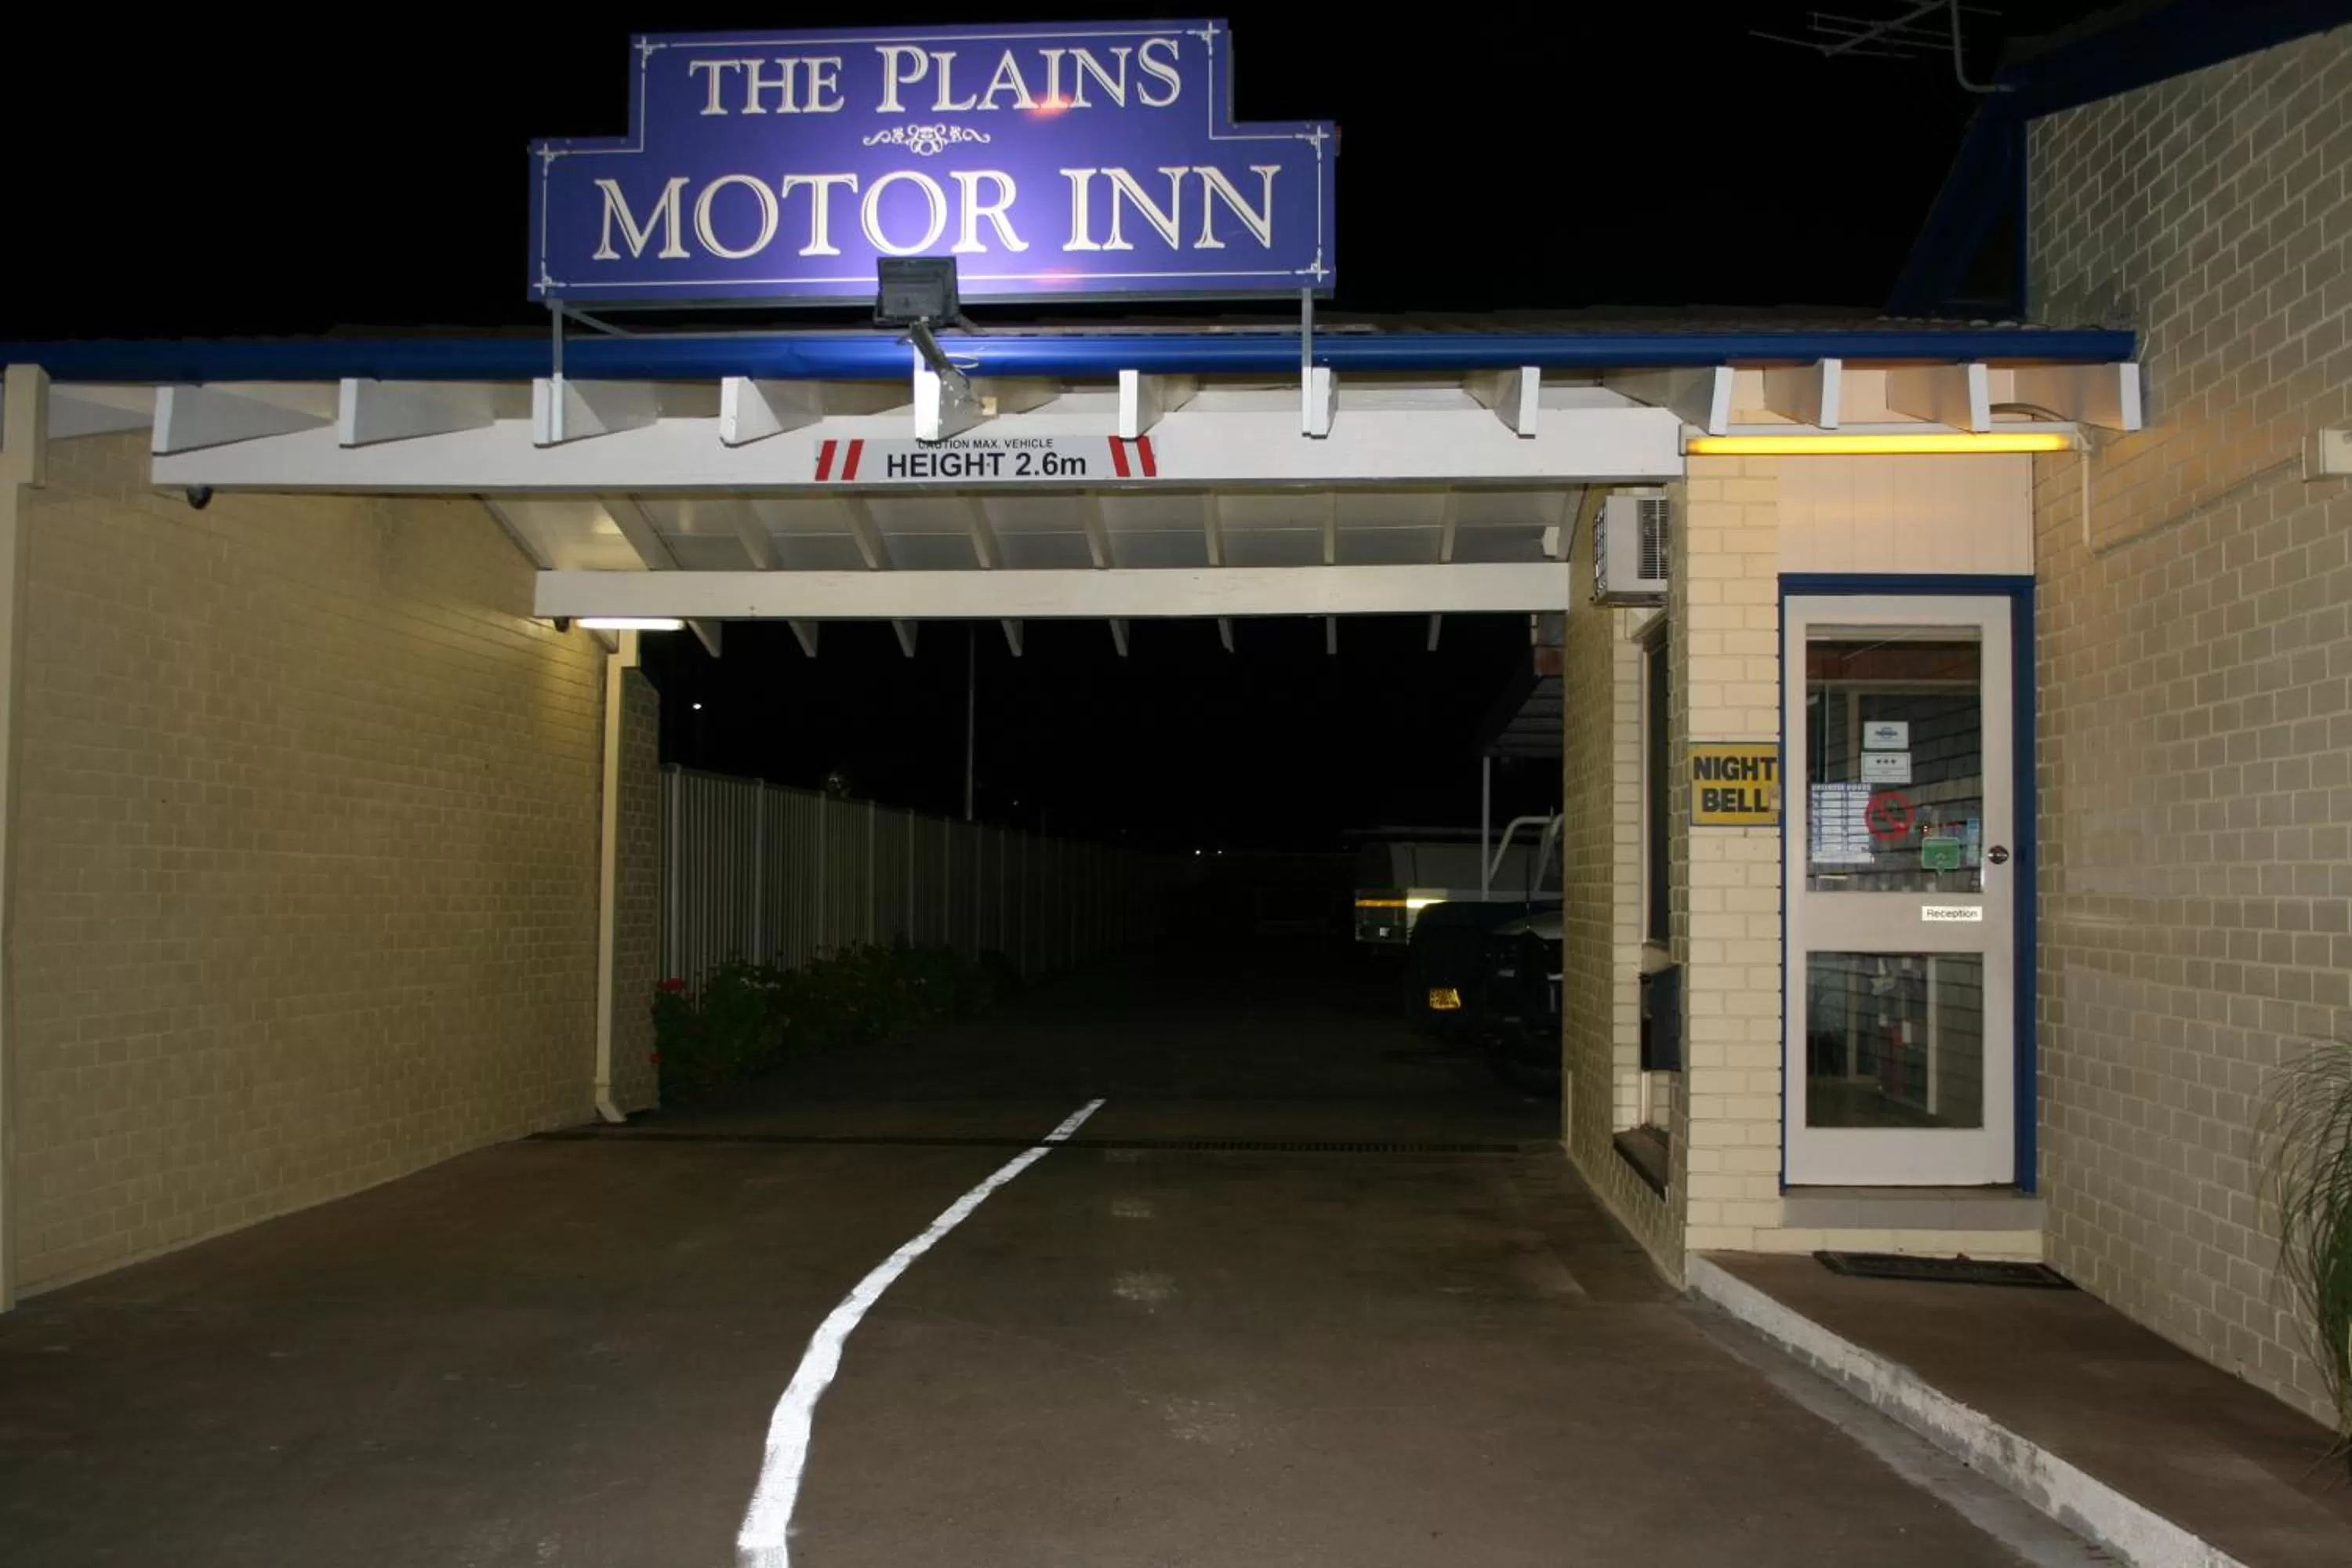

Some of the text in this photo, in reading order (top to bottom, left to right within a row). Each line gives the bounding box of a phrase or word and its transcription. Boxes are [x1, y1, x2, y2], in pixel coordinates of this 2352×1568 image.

[688, 38, 1182, 116] THE PLAINS
[592, 164, 1281, 260] MOTOR INN
[1004, 438, 1054, 449] VEHICLE
[887, 451, 1087, 477] HEIGHT 2.6m
[1693, 757, 1777, 781] NIGHT
[1701, 789, 1769, 813] BELL
[1926, 909, 1978, 919] Reception
